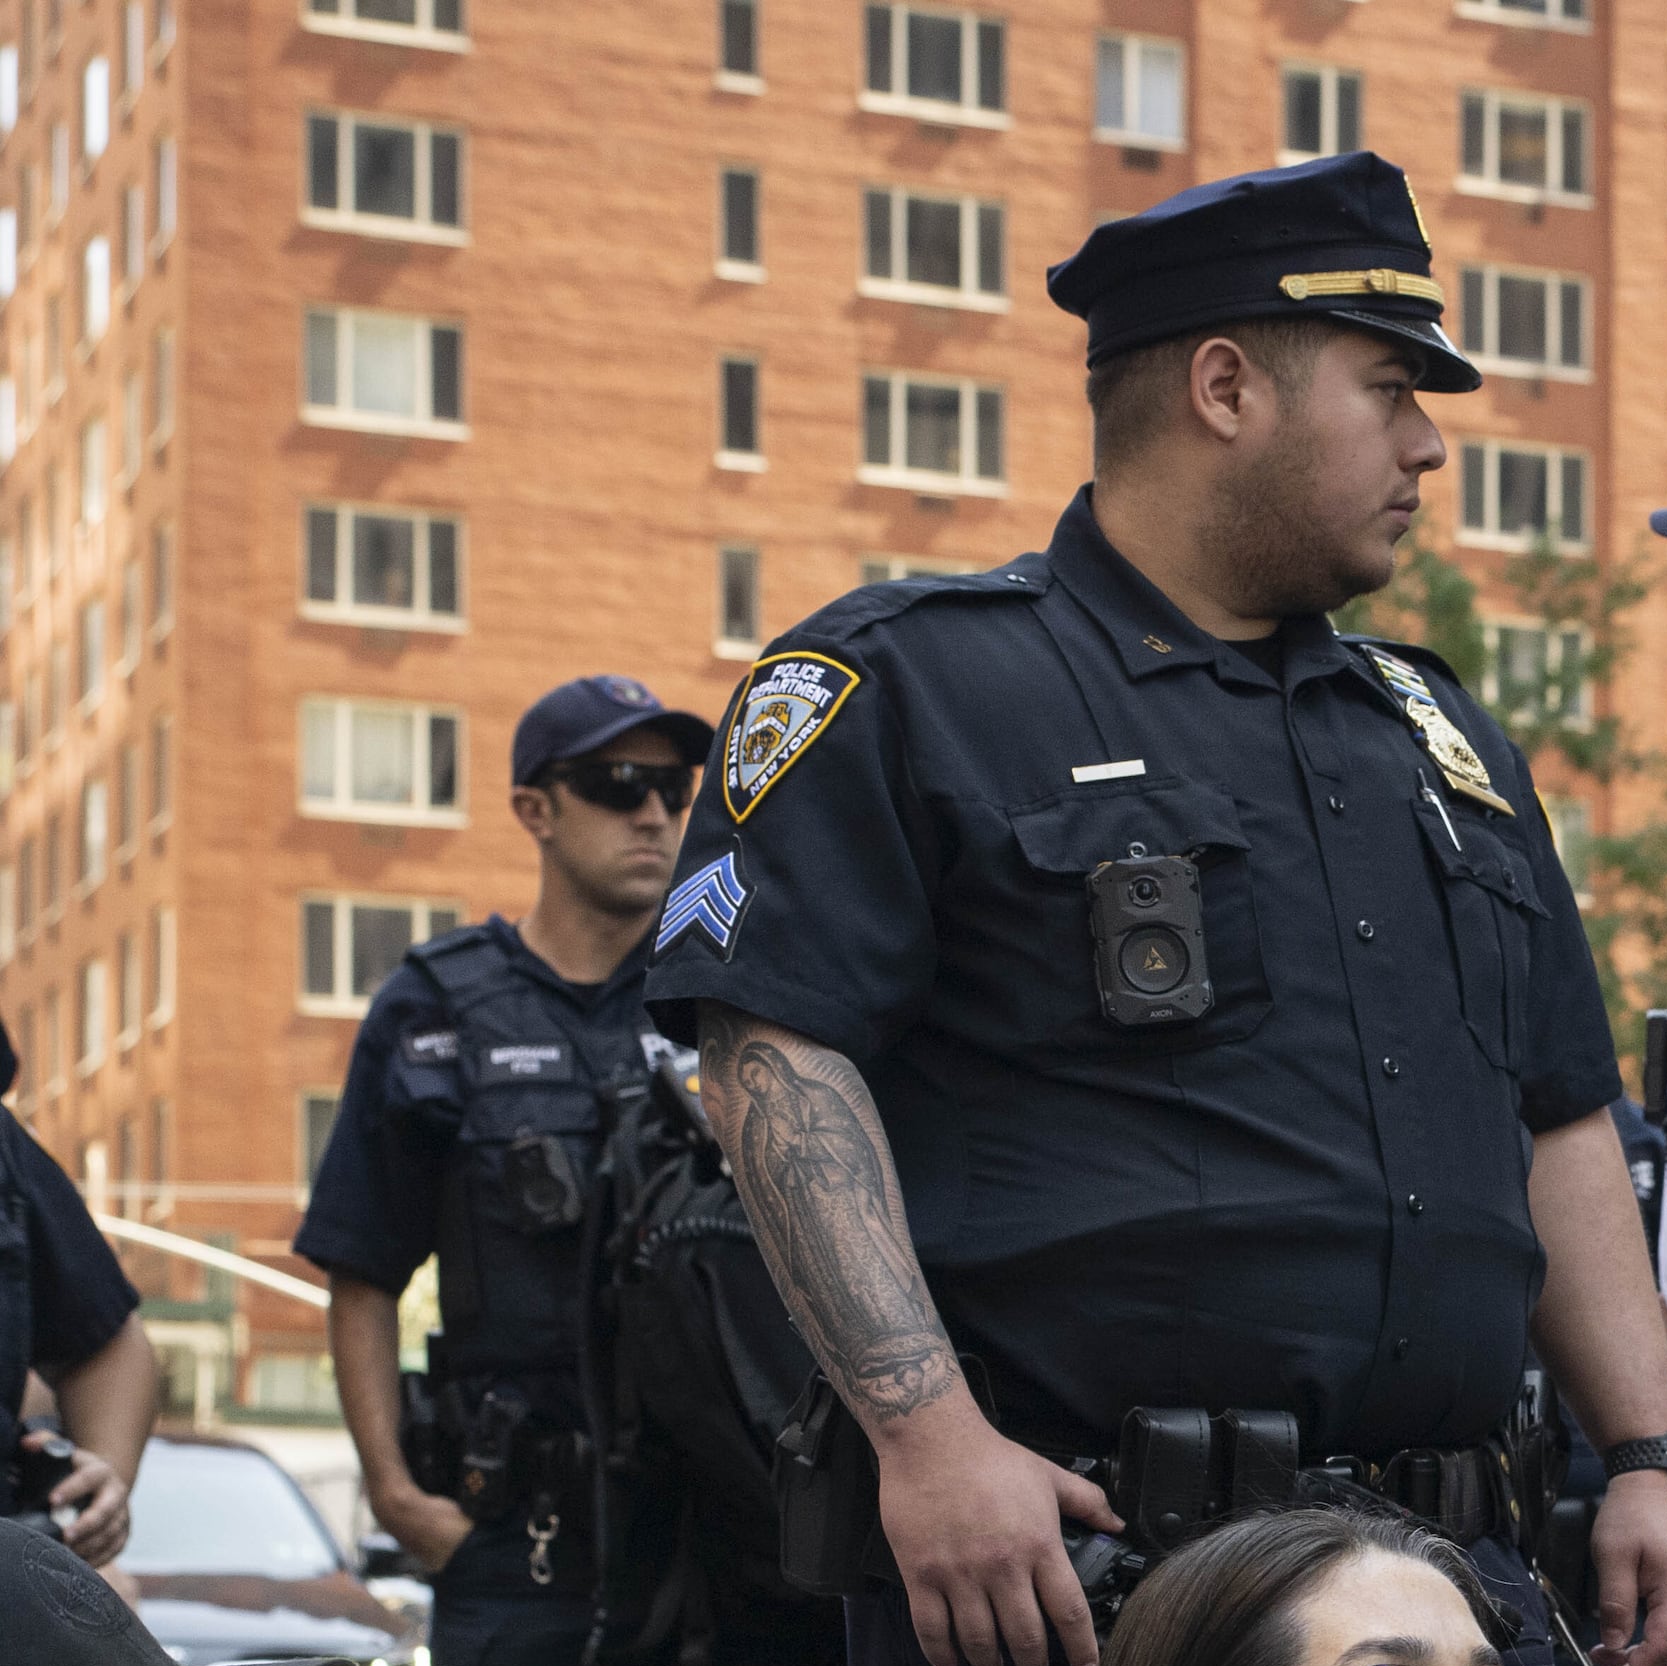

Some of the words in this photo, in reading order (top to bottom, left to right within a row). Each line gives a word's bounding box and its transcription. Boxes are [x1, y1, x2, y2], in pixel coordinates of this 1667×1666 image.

[771, 662, 826, 683] POLICE
[746, 679, 833, 708] DEPARTMENT
[750, 761, 778, 797] NEW
[778, 716, 822, 761] YORK
[1150, 1009, 1173, 1018] AXON
